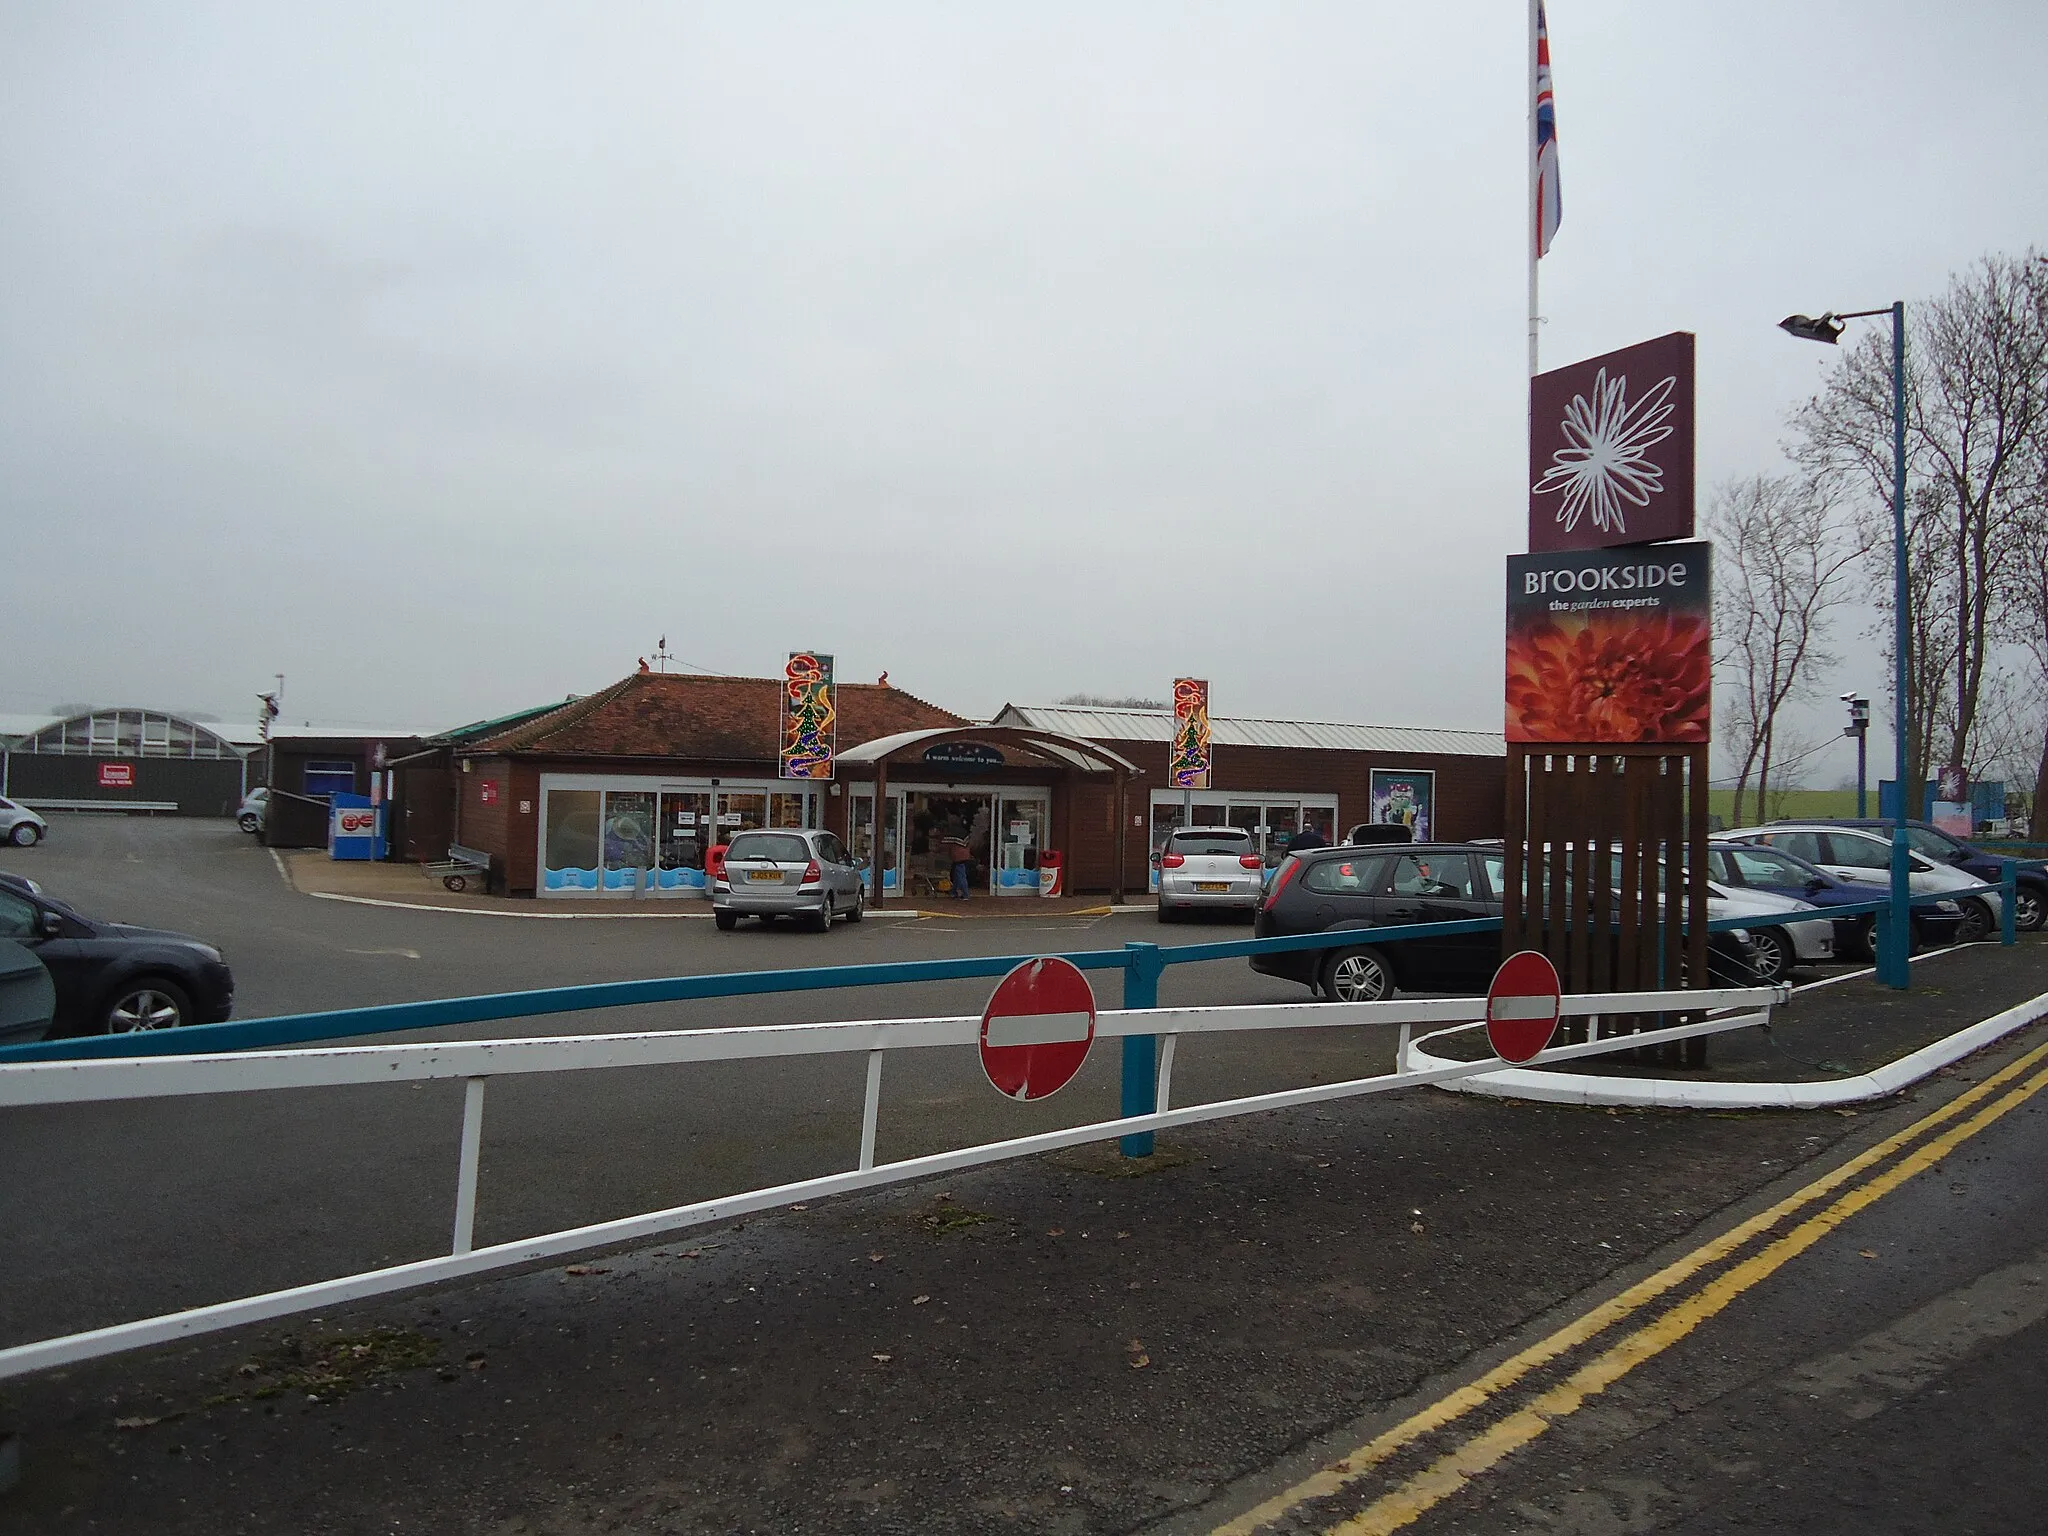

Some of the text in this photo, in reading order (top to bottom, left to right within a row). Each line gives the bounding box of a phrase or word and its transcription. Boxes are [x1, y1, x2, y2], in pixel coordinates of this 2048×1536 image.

[1549, 597, 1660, 613] the garden experts
[977, 756, 985, 764] to
